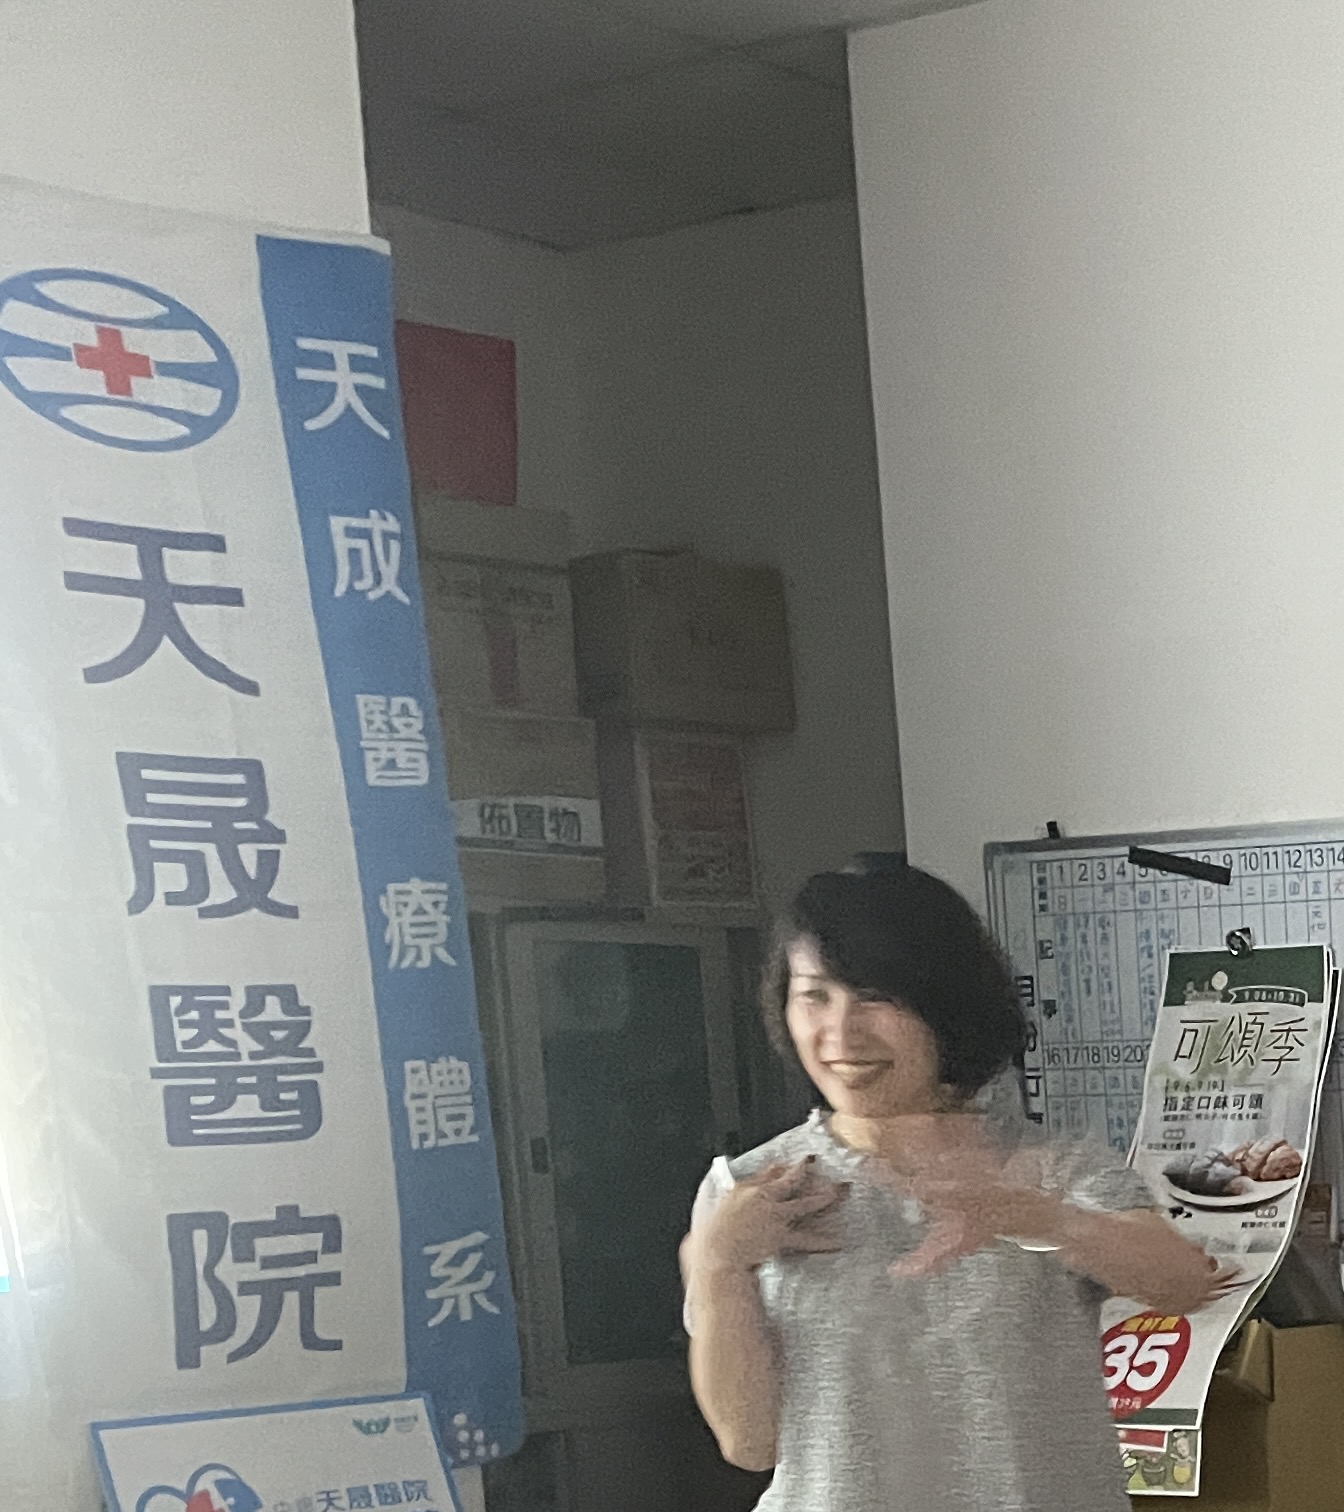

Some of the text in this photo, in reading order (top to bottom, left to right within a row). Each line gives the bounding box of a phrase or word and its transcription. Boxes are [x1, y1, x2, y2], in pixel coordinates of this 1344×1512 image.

[295, 338, 501, 1327] 天成醫療體系
[1078, 863, 1088, 881] 2
[1097, 862, 1106, 880] 3
[1117, 861, 1125, 878] 4
[1242, 854, 1259, 871] 10
[1263, 852, 1280, 870] 11
[1285, 850, 1302, 868] 12
[1306, 848, 1324, 867] 13
[62, 516, 343, 1370] 天晟醫院
[1065, 1048, 1080, 1064] 17
[1085, 1047, 1101, 1064] 18
[1106, 1045, 1122, 1064] 19
[1124, 1045, 1144, 1063] 20
[1173, 1011, 1309, 1076] 可頌季
[1103, 1332, 1181, 1391] 35
